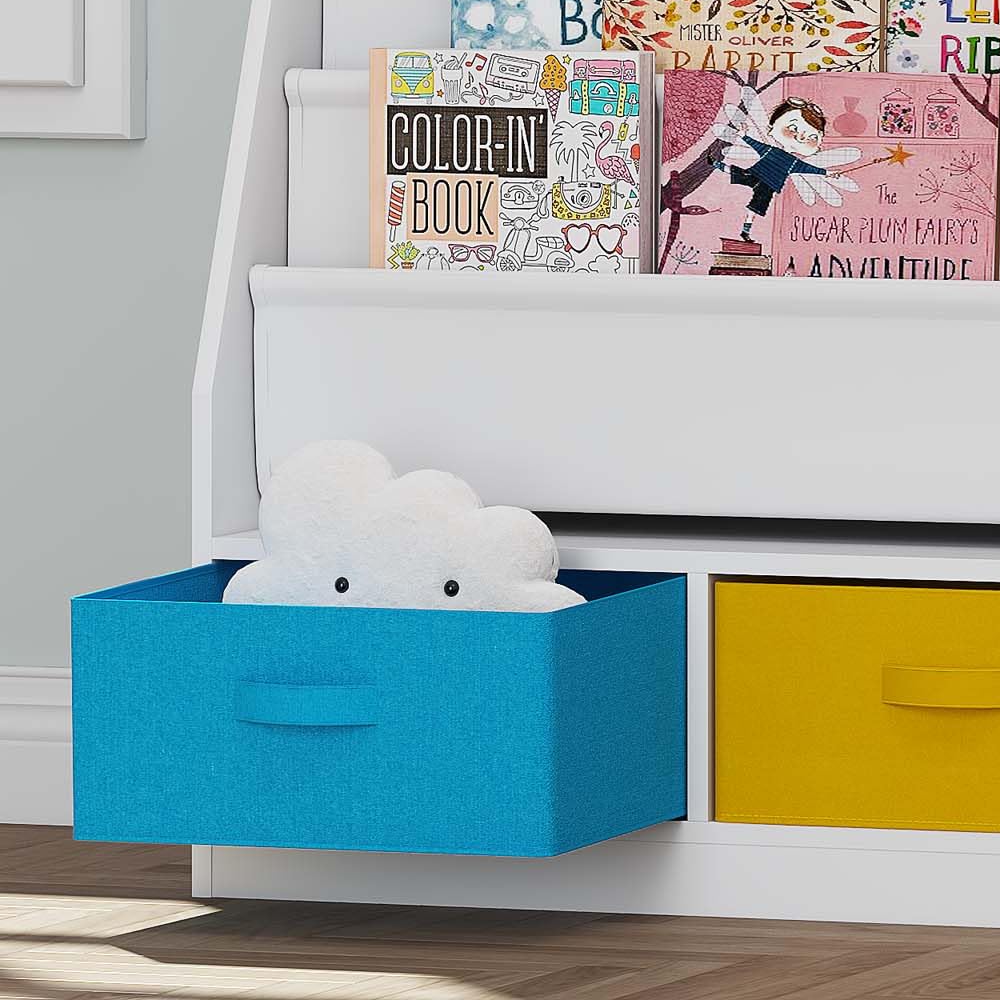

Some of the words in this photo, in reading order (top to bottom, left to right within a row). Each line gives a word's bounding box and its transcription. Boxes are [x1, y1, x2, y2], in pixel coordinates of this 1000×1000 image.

[679, 23, 723, 42] MISTER
[728, 36, 794, 47] OLIVER
[875, 183, 898, 205] The
[411, 178, 495, 236] BOOK
[790, 215, 854, 244] SUGAR
[859, 217, 908, 245] PLUM
[915, 217, 979, 246] FAIRY'S
